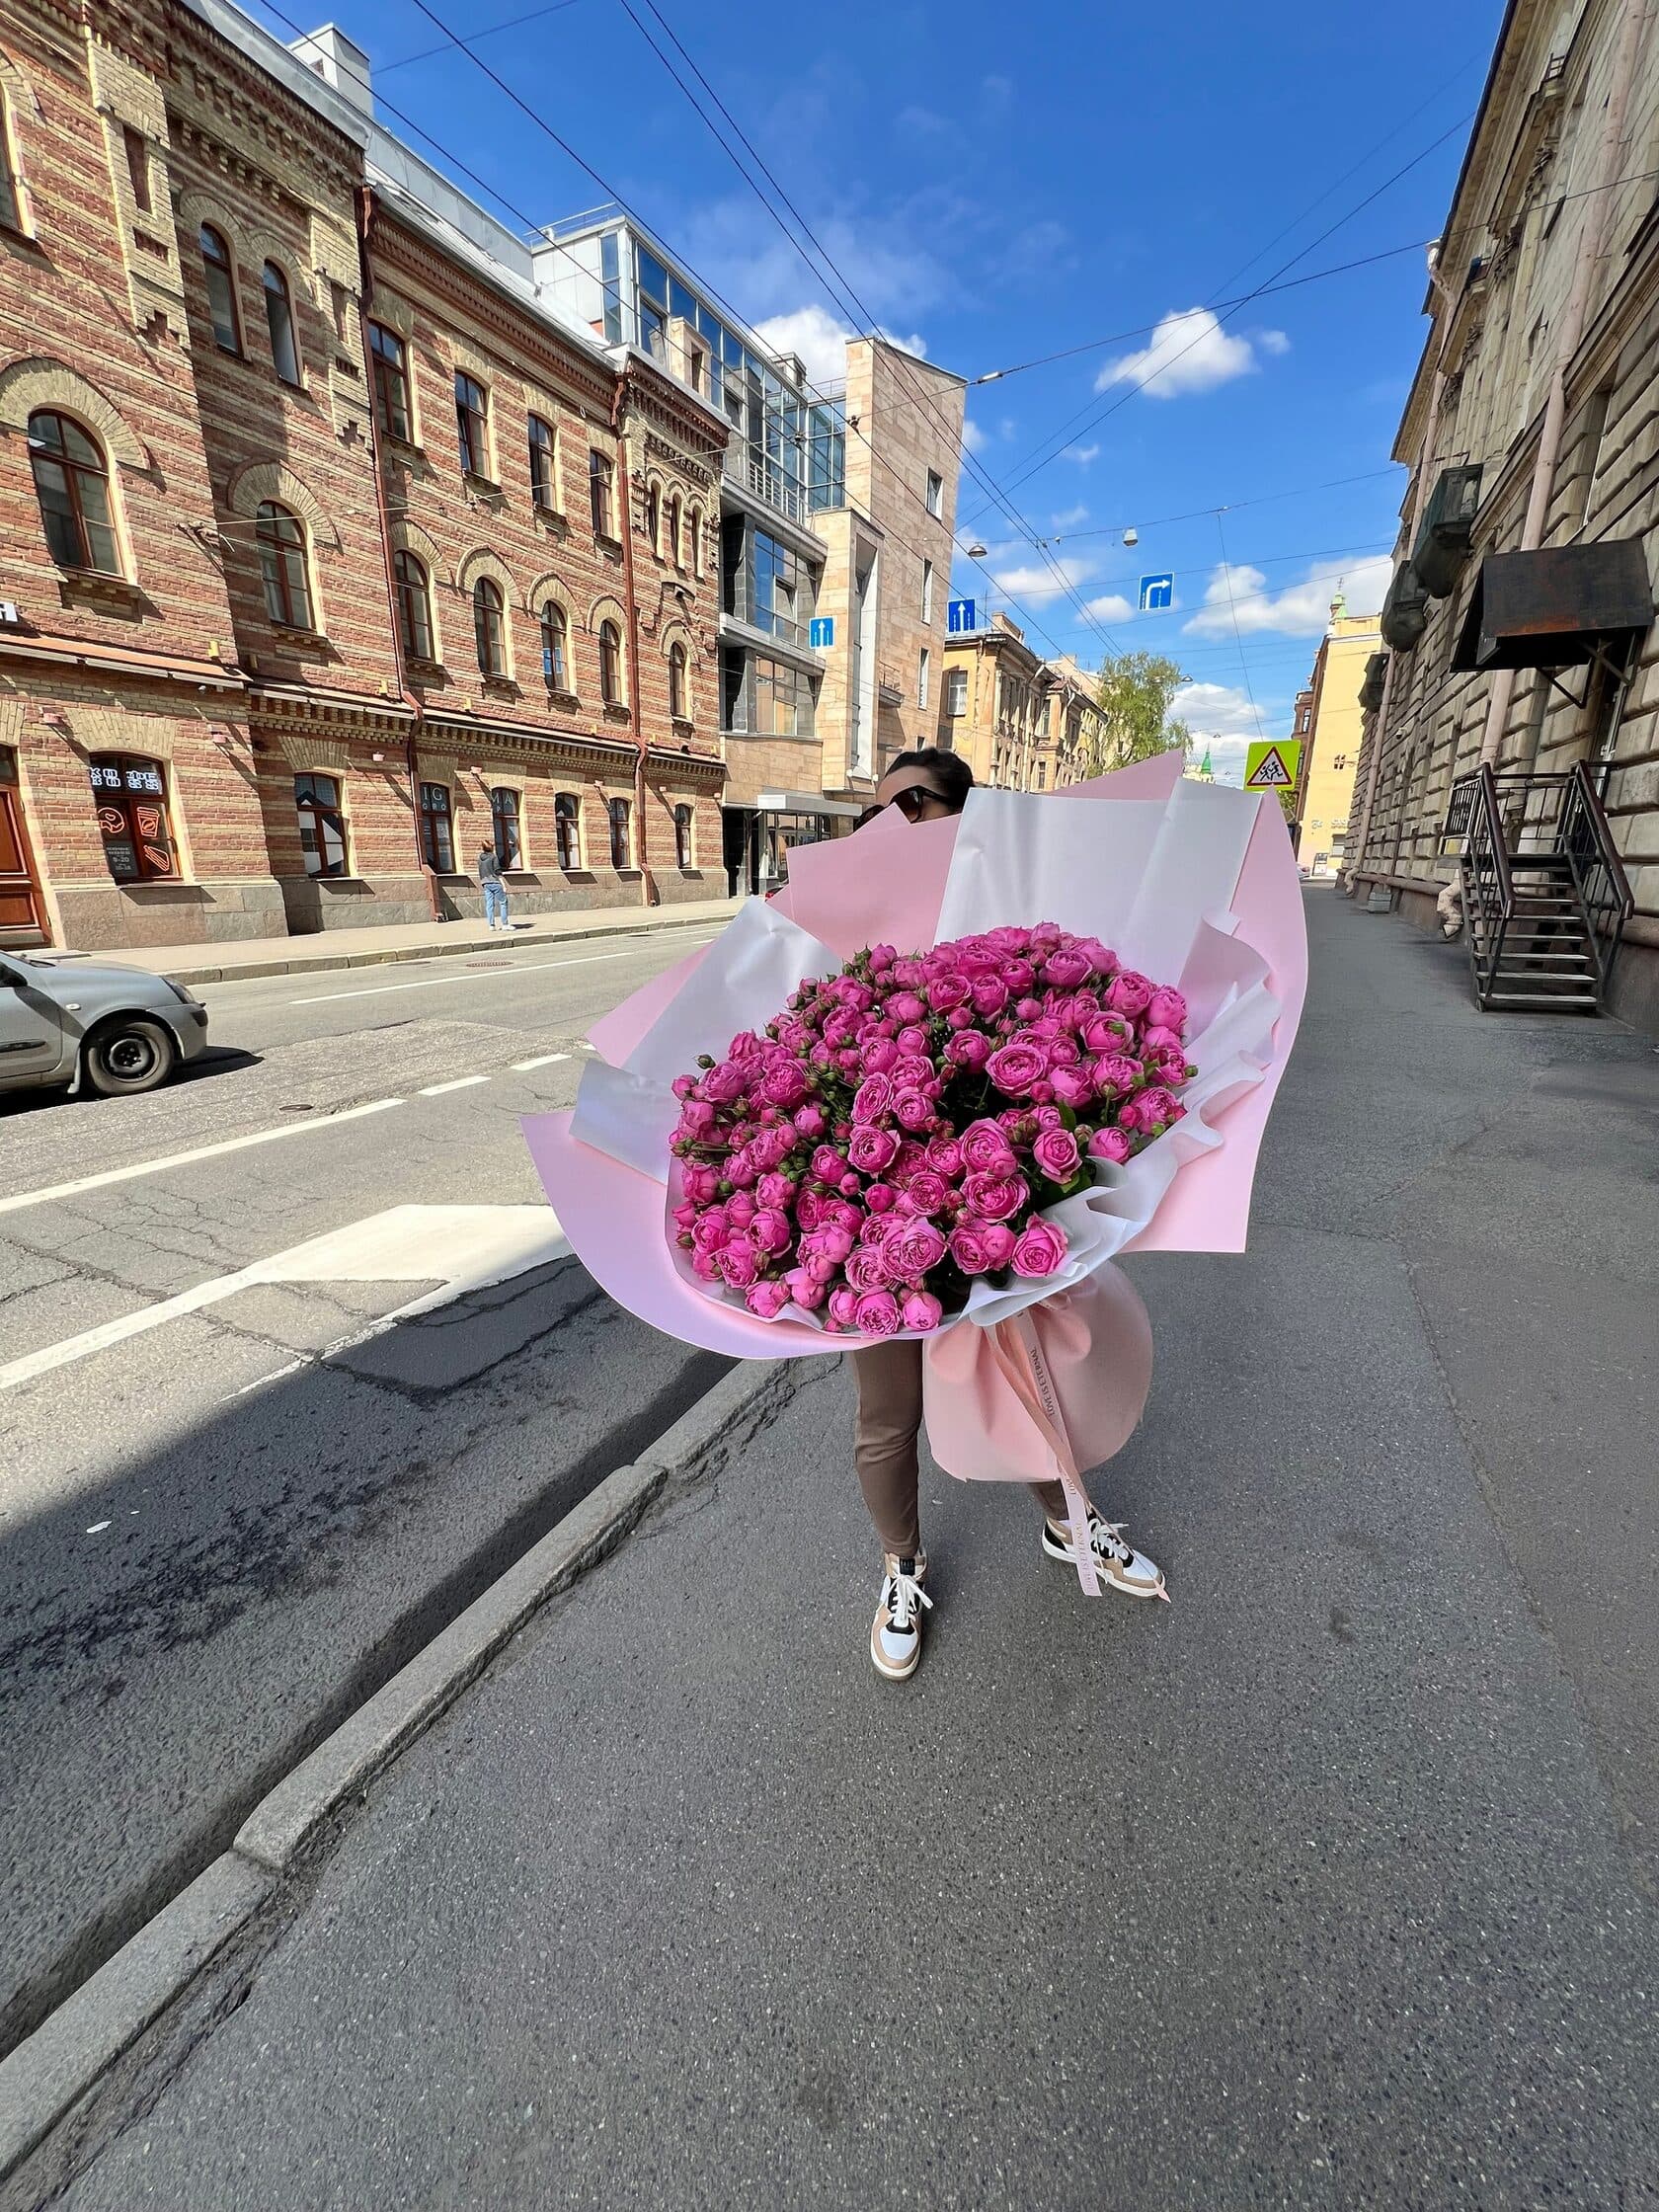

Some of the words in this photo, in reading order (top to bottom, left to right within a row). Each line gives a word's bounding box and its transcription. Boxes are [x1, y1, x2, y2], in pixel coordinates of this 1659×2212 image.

[1030, 1346, 1048, 1386] ETERNAL
[1041, 1385, 1050, 1395] IS
[1045, 1395, 1056, 1416] LOVE
